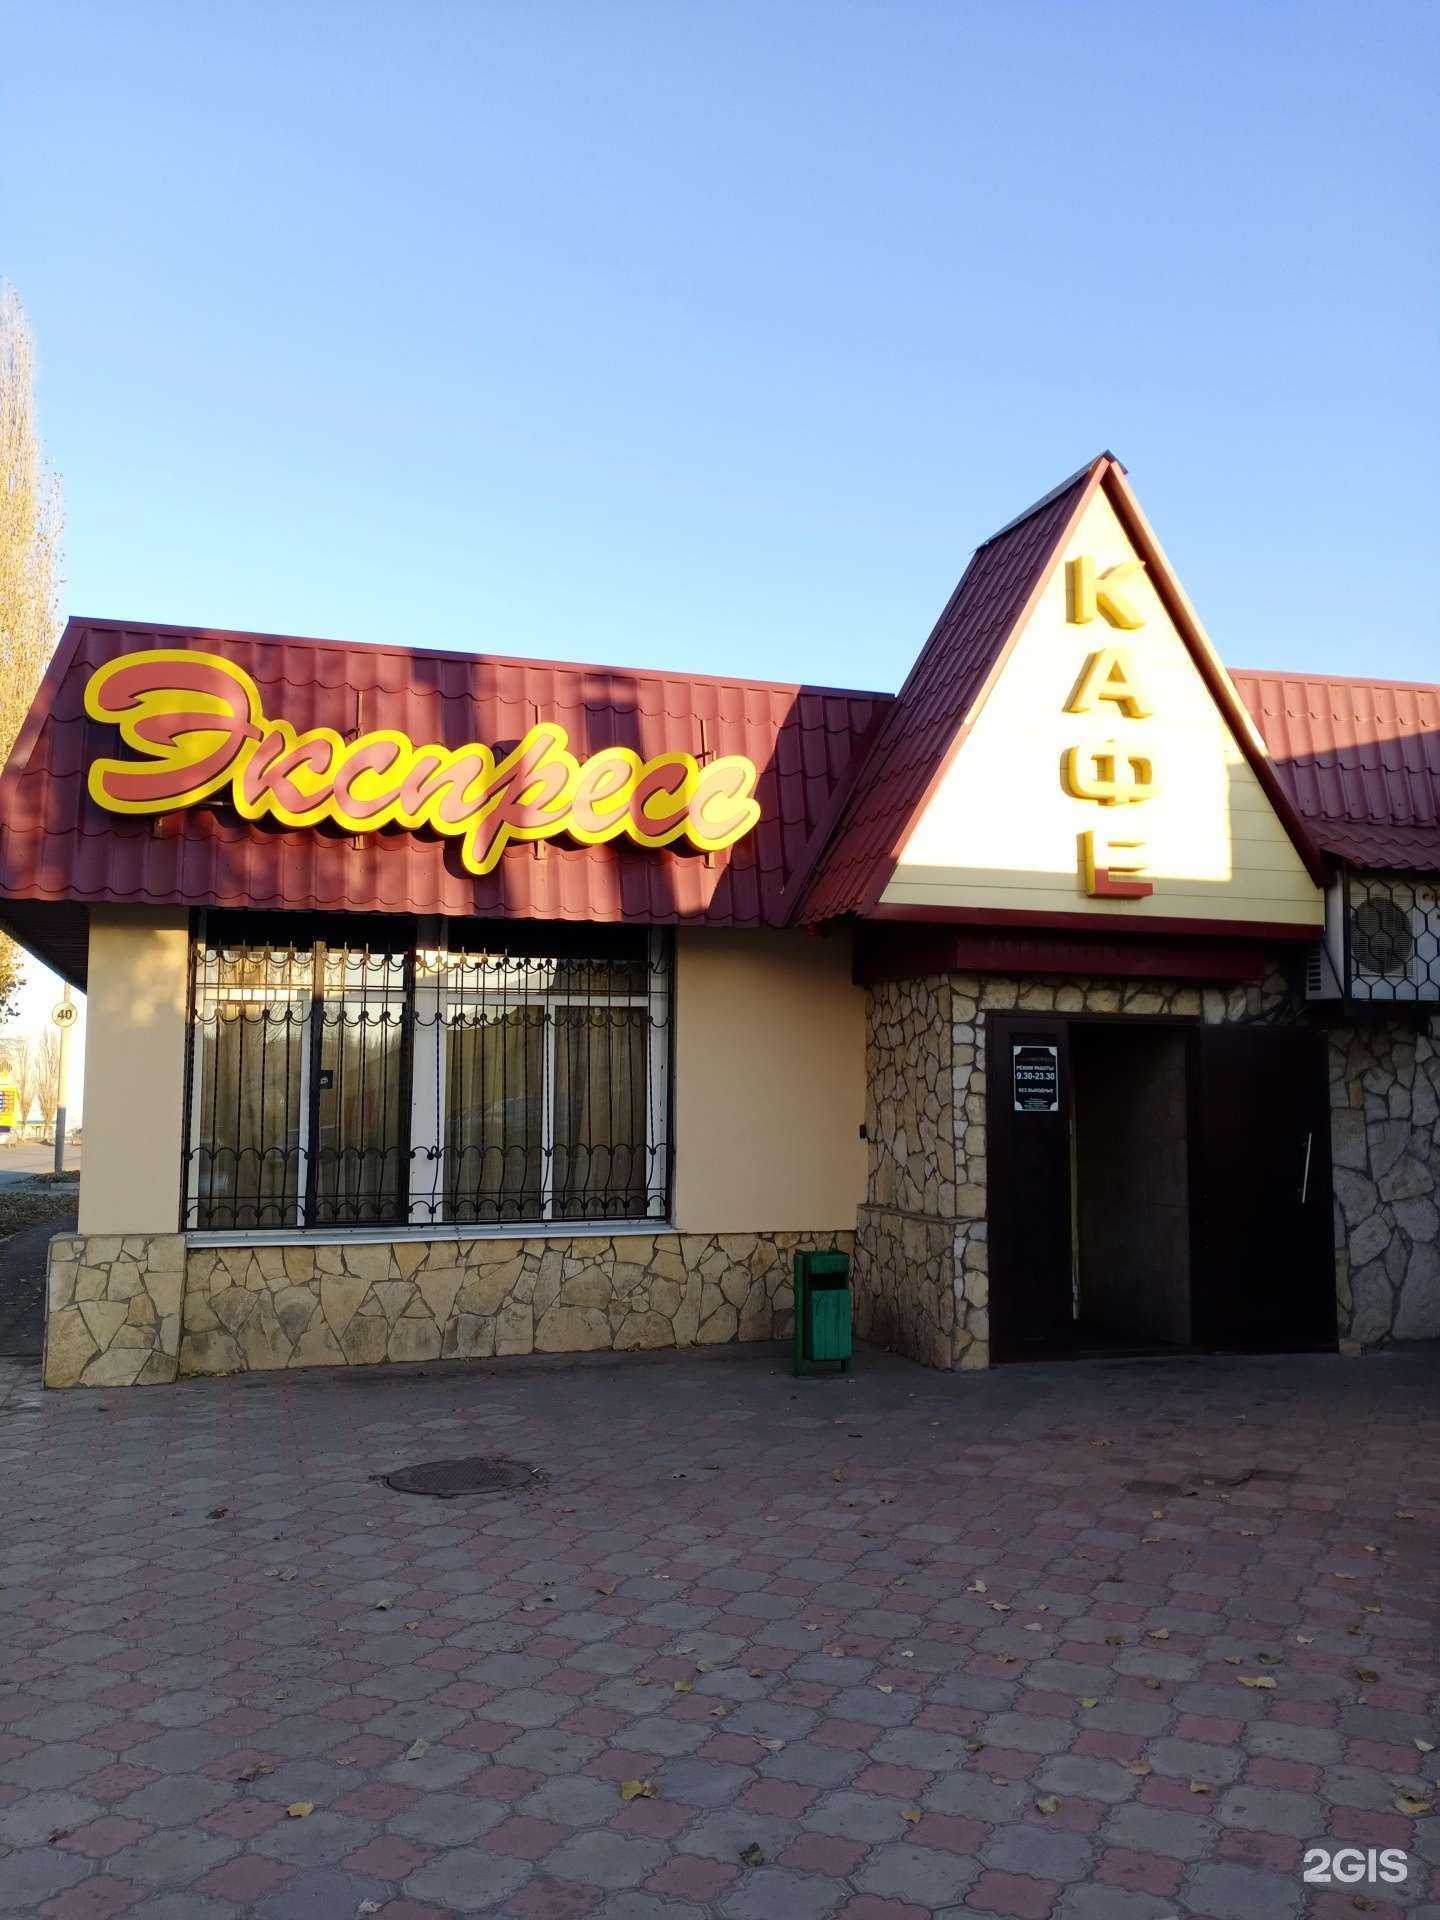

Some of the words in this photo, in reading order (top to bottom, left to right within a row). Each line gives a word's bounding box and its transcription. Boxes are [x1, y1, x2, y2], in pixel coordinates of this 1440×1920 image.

[85, 649, 761, 875] Экспресс
[1060, 555, 1158, 899] КАФЕ
[57, 1009, 72, 1020] 40
